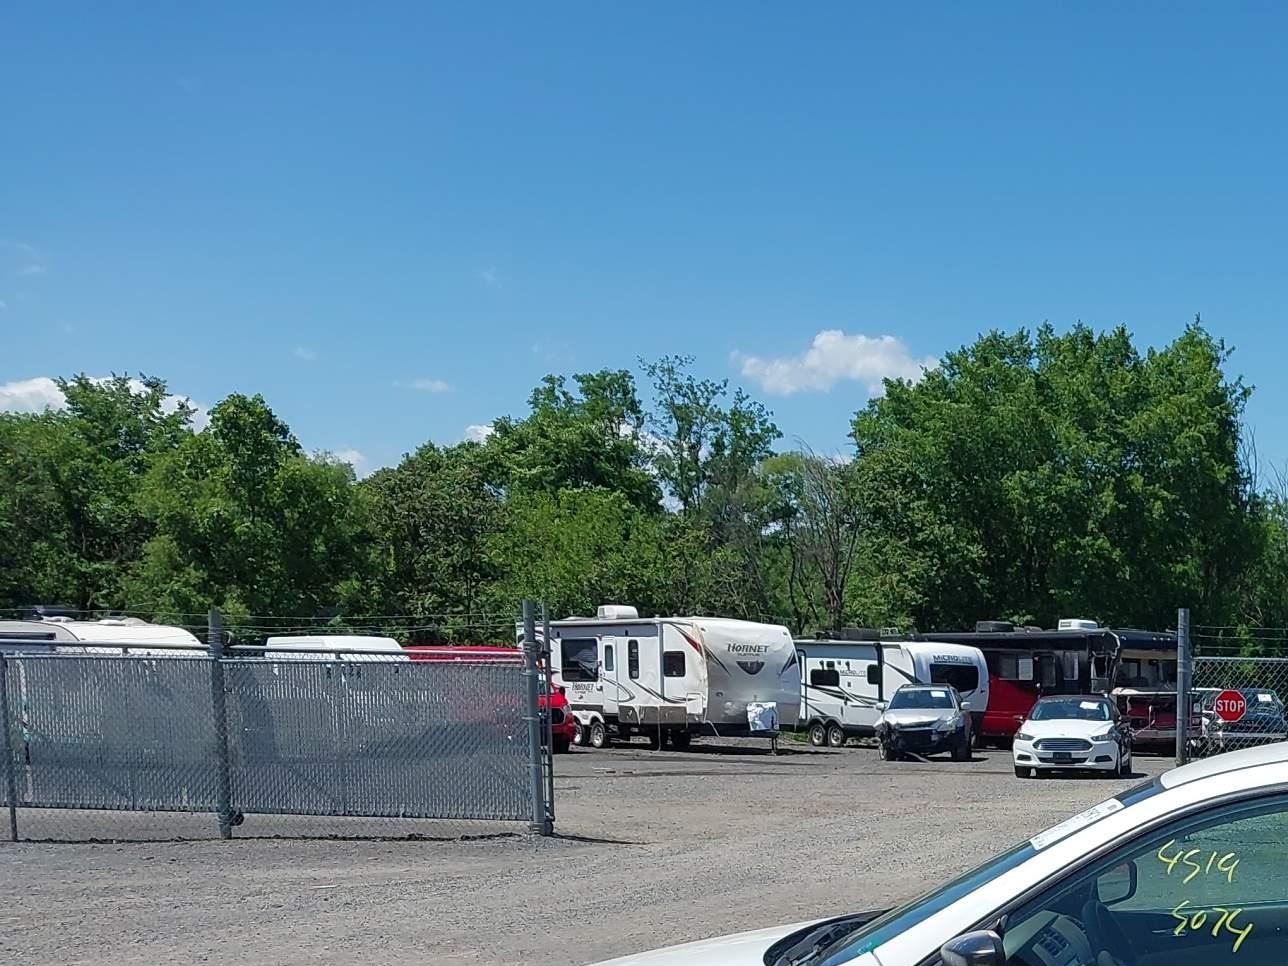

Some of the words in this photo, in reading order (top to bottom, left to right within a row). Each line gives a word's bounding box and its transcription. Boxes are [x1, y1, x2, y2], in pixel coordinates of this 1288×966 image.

[727, 643, 770, 653] HORNET
[1216, 700, 1244, 712] STOP
[1157, 839, 1240, 885] 4519
[1171, 900, 1254, 953] 5074
